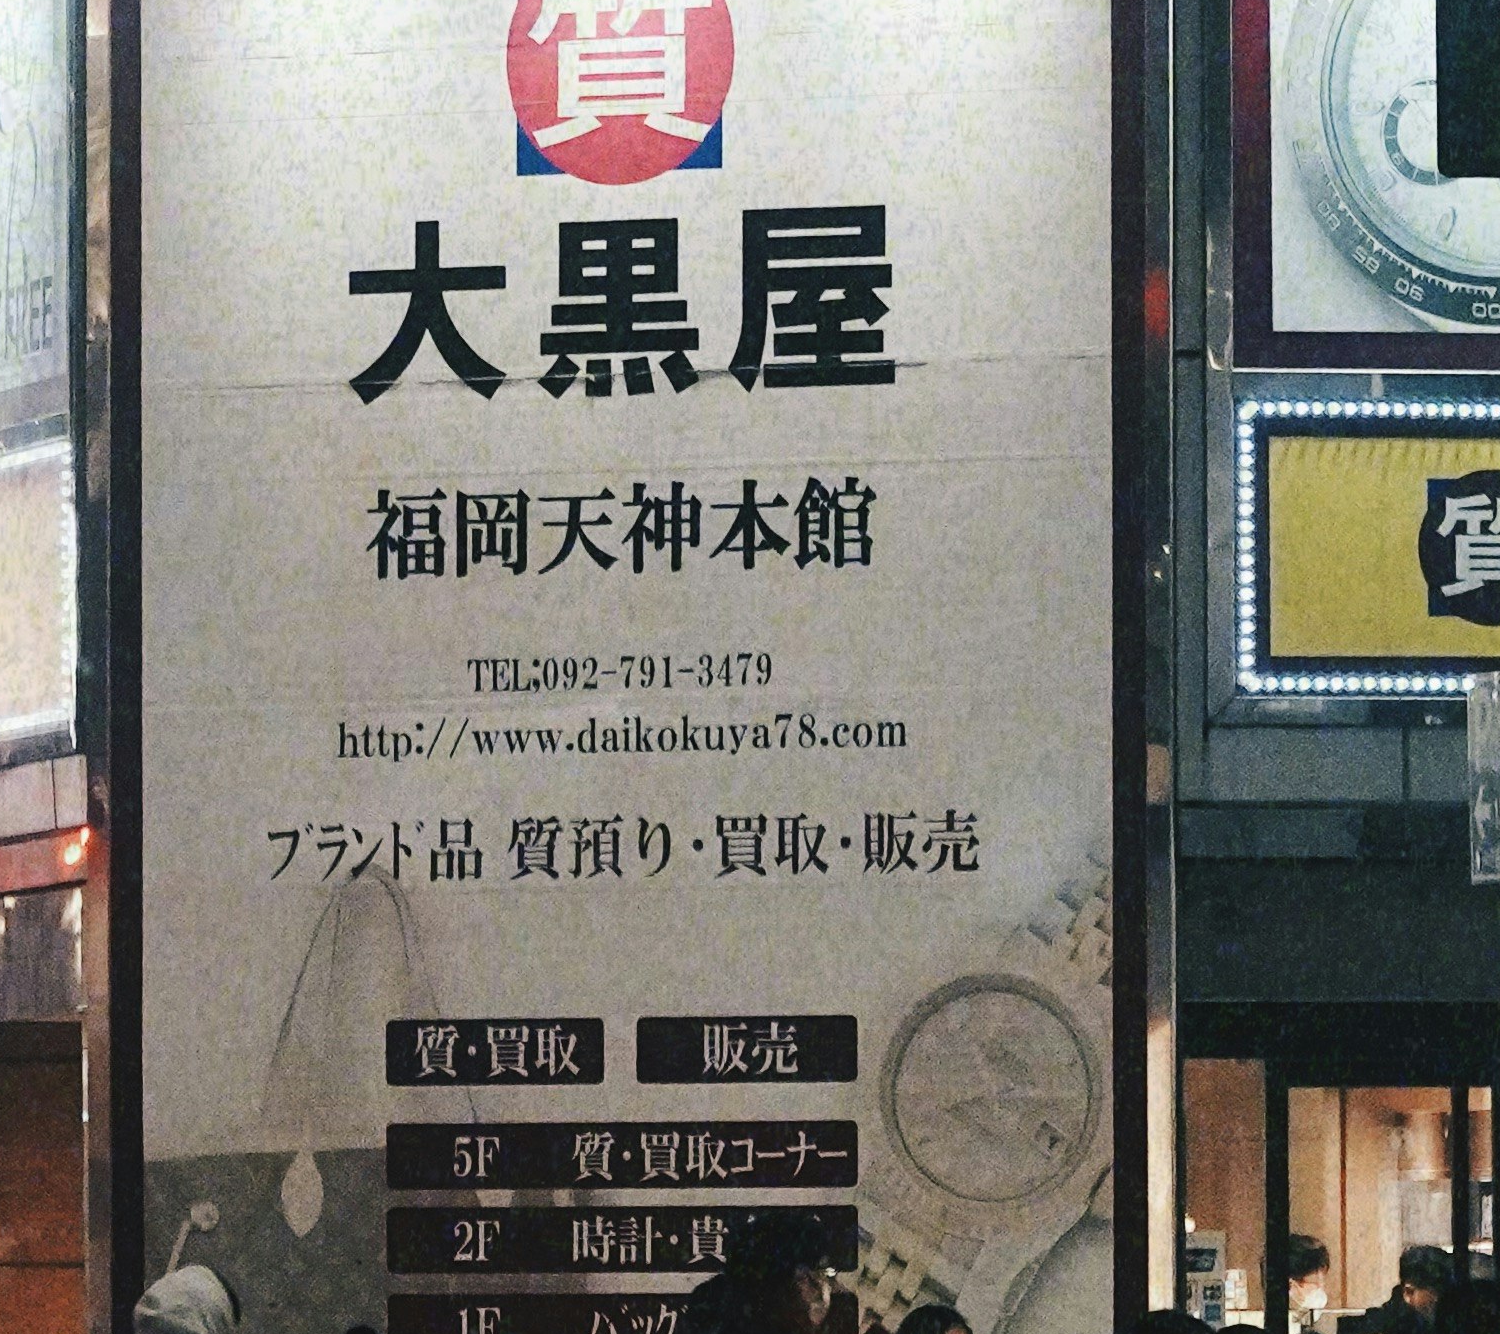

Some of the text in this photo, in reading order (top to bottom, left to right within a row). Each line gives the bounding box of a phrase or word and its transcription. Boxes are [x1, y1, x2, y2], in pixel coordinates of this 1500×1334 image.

[346, 204, 897, 405] 大黒屋
[364, 476, 878, 581] 福岡天神本館
[336, 712, 908, 763] http://www.daikokuya78.com
[265, 806, 981, 883] ブランド品 質預り・買取・販売
[414, 1023, 582, 1079] 質・買取
[701, 1021, 800, 1076] 販売
[452, 1130, 849, 1183] 5F 質・買取コーナー
[452, 1219, 500, 1263] 2F
